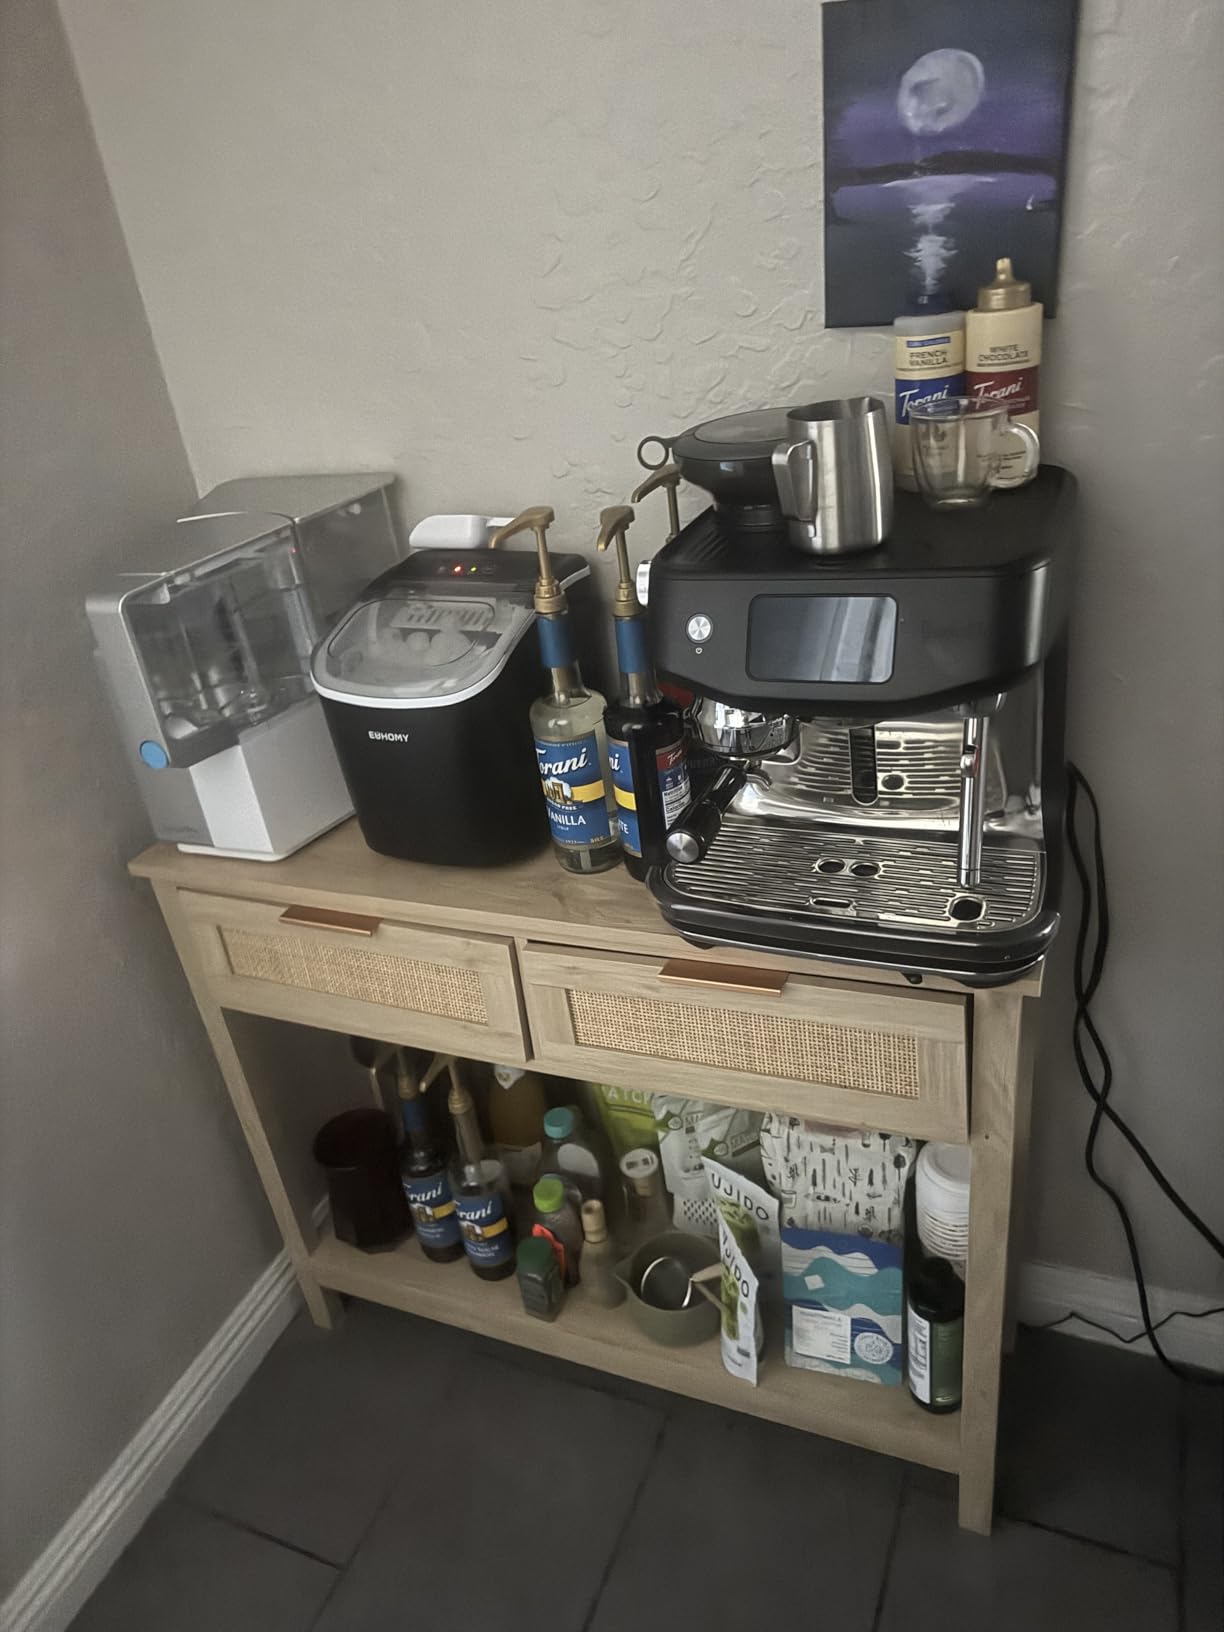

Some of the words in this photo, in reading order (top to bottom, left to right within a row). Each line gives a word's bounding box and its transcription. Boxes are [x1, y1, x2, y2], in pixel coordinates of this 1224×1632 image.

[909, 350, 947, 359] FRENCH
[989, 344, 1019, 353] WHITE
[909, 357, 949, 367] VANILLA
[978, 350, 1029, 362] CHOCOLATE
[974, 377, 1024, 409] Torani
[899, 385, 949, 417] Torani
[711, 1172, 769, 1221] UJIDO
